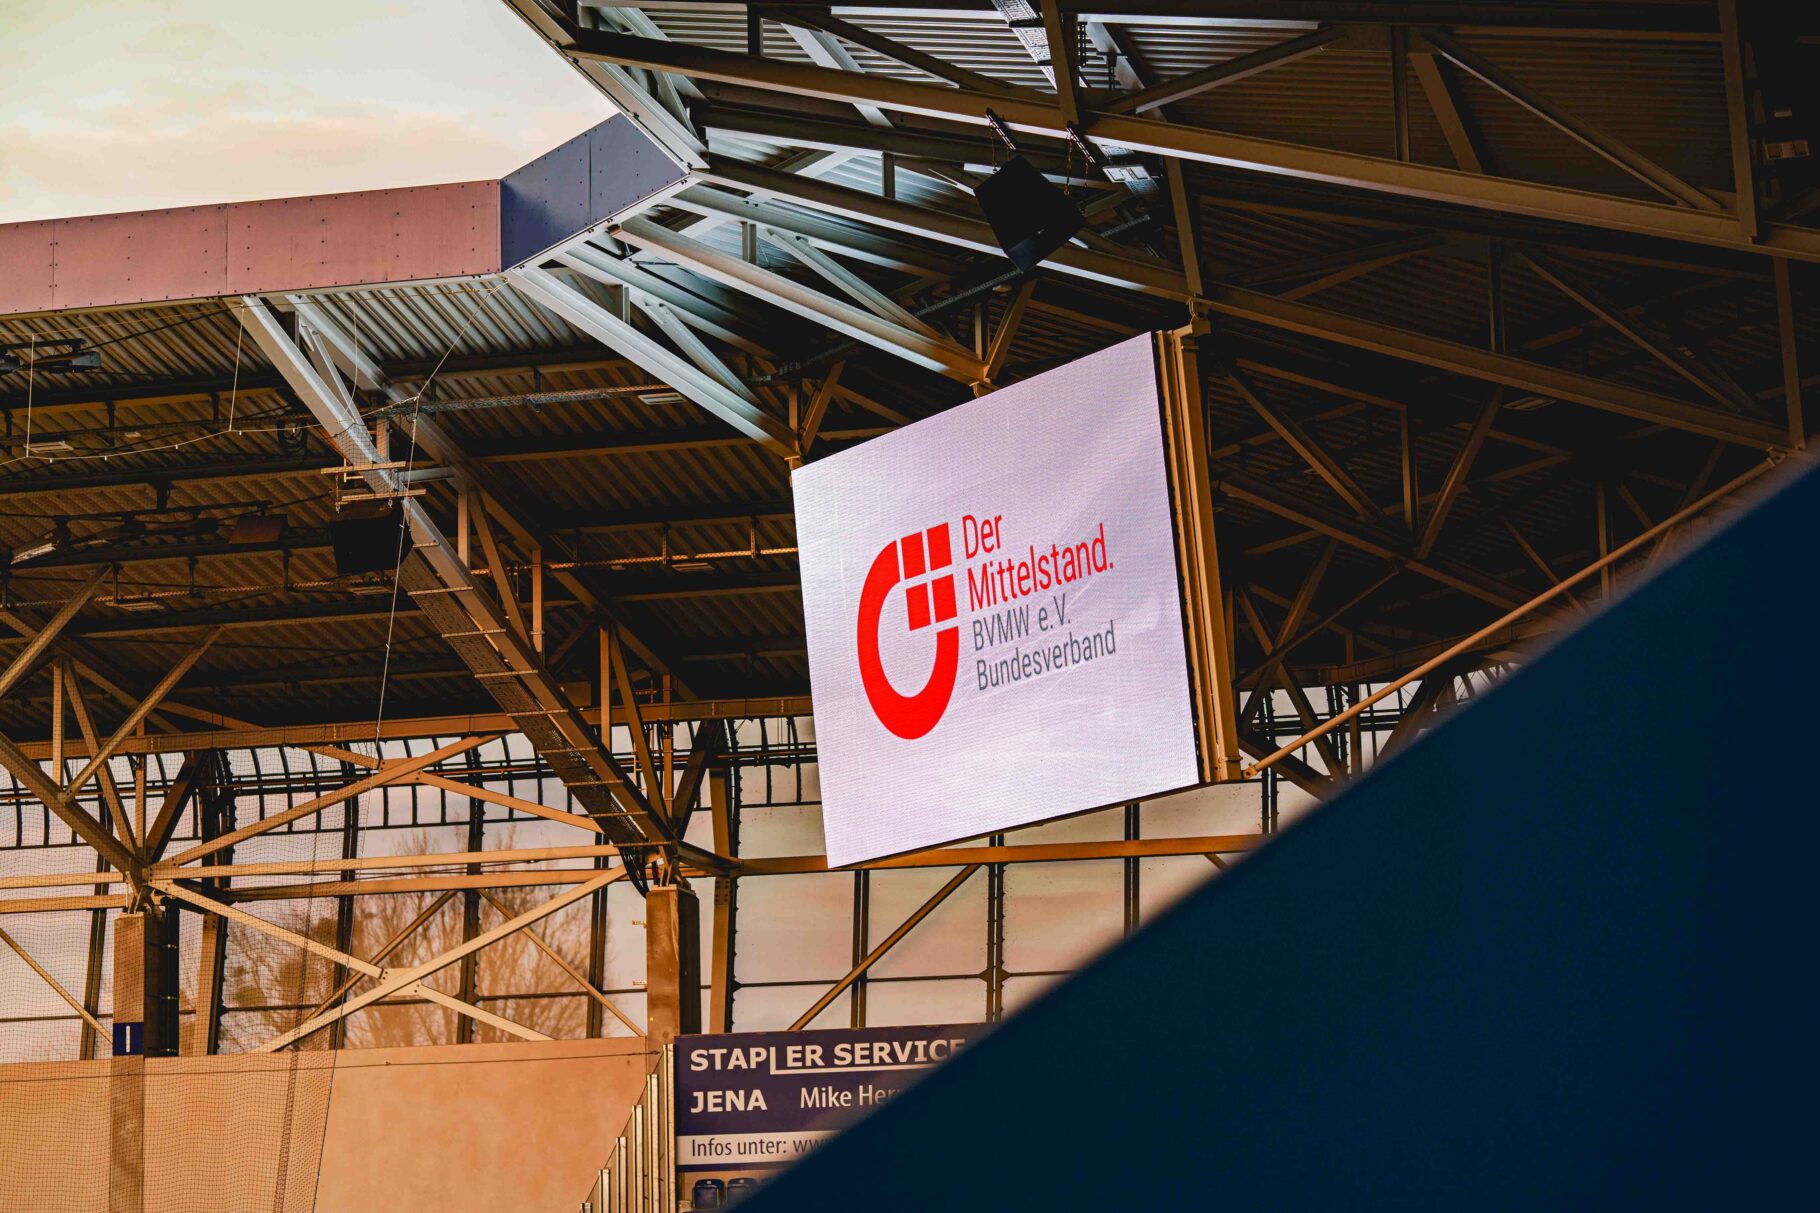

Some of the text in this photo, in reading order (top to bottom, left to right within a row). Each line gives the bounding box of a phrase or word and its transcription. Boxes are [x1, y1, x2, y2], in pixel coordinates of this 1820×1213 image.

[962, 514, 1003, 560] Der
[967, 522, 1115, 613] Mittelstand.
[972, 604, 1030, 652] BVMW
[976, 619, 1117, 691] Bundesverband
[690, 1044, 826, 1076] STAPLER
[690, 1089, 768, 1114] JENA
[800, 1085, 852, 1109] Mike
[691, 1137, 733, 1157] Infos
[737, 1138, 787, 1155] unter:
